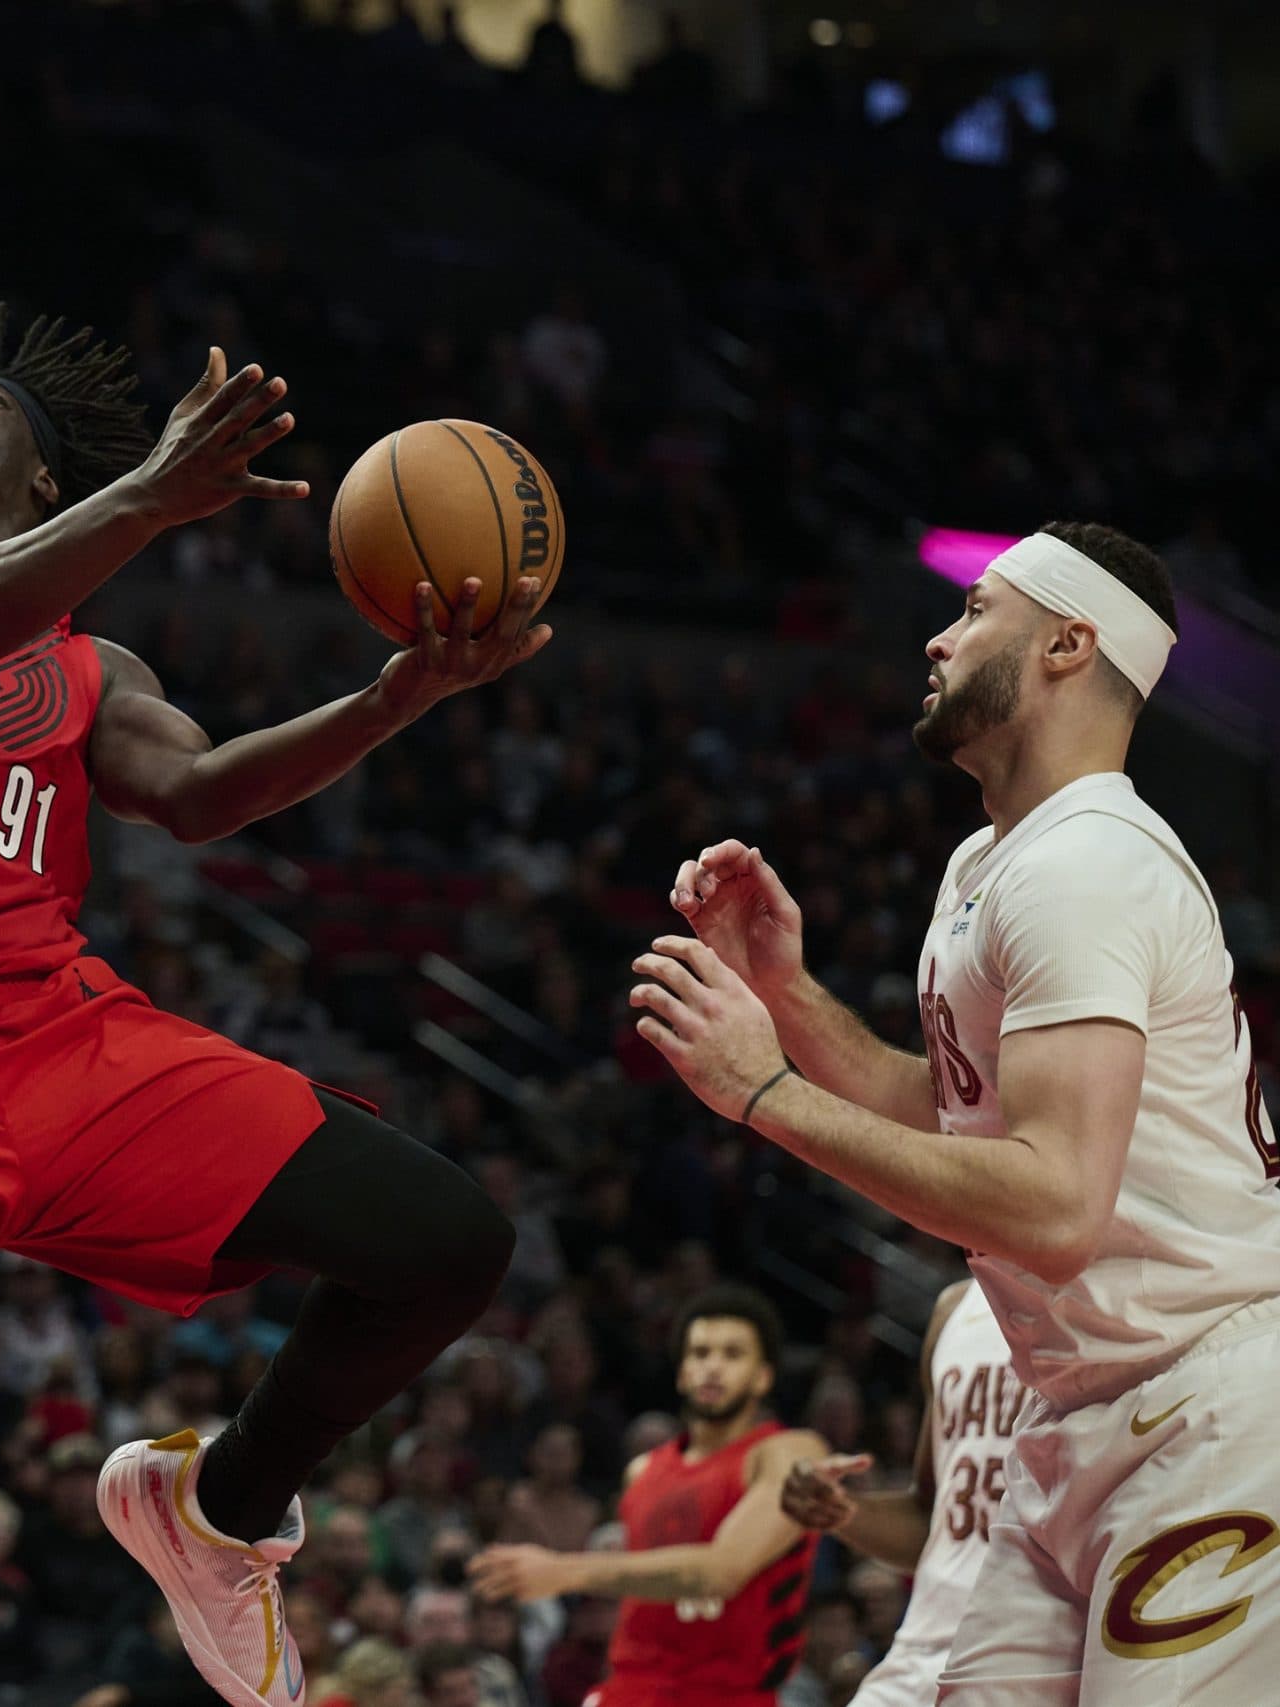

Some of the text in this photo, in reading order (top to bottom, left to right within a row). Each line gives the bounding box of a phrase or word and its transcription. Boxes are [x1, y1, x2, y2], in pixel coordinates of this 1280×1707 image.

[484, 430, 550, 572] Wilson
[939, 1365, 1027, 1440] CAV
[1100, 1510, 1280, 1660] C
